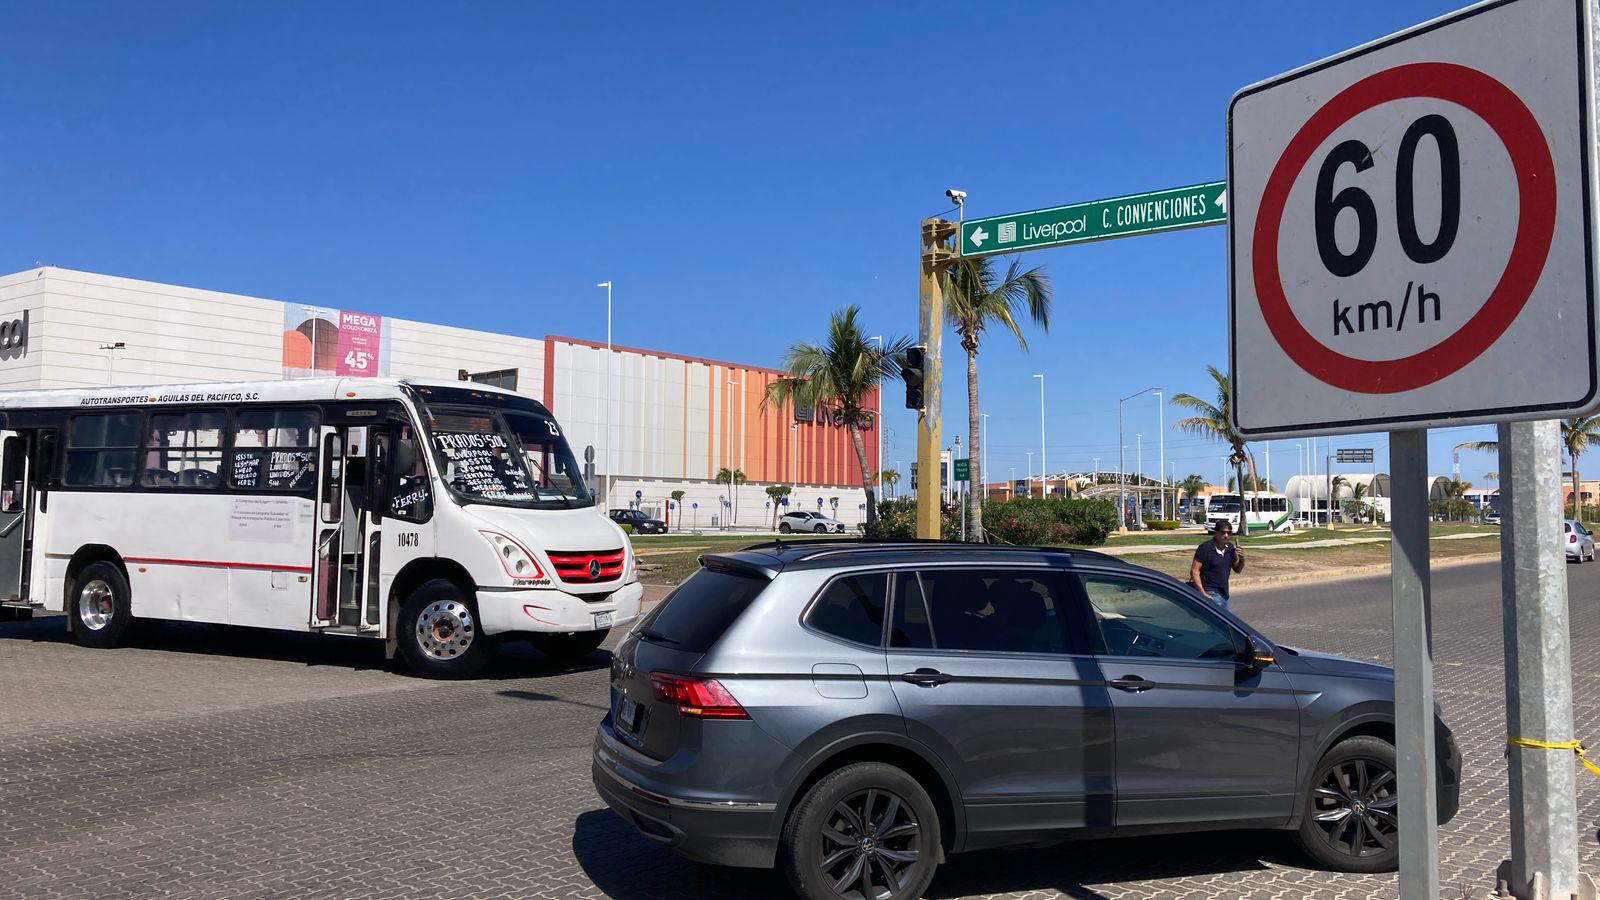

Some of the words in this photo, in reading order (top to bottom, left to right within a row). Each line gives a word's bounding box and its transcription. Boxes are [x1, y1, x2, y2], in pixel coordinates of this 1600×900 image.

[1314, 113, 1461, 278] 60
[1102, 208, 1113, 229] C.
[1117, 194, 1207, 225] CONVENCIONES
[1022, 215, 1087, 241] Liverpool
[1333, 281, 1442, 336] km/h
[342, 313, 377, 328] MEGA
[80, 396, 149, 406] AUTOTRANSPORTES
[191, 394, 205, 402] DEL
[245, 393, 260, 401] S.C.
[437, 434, 484, 448] PRADOS
[398, 532, 419, 547] 10478
